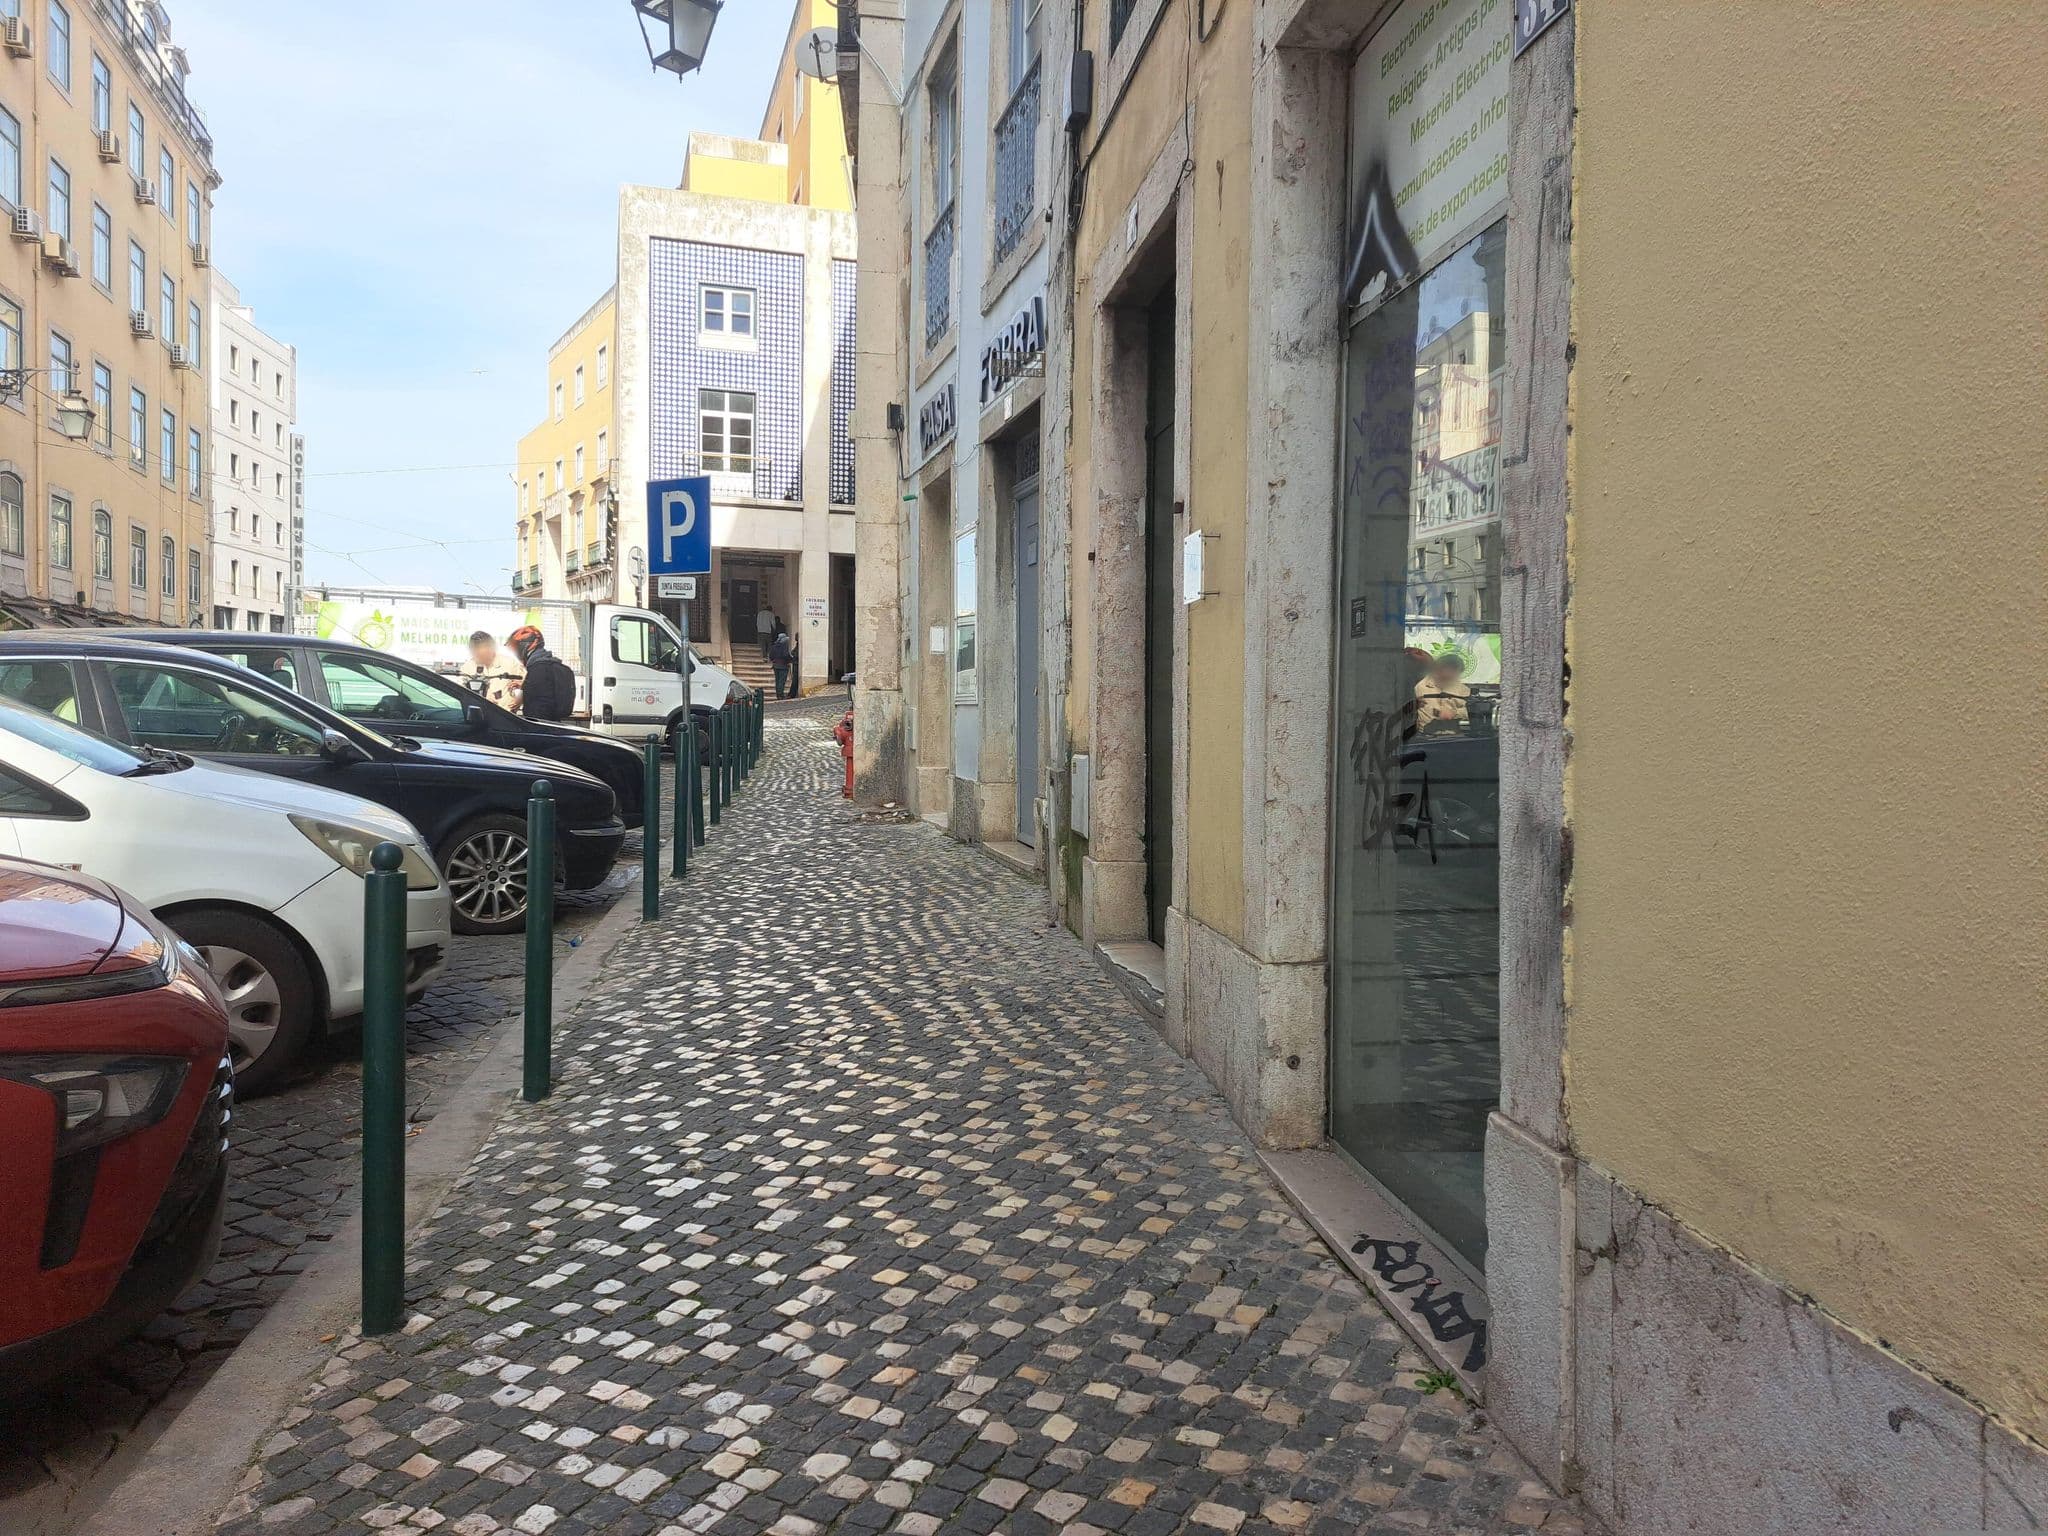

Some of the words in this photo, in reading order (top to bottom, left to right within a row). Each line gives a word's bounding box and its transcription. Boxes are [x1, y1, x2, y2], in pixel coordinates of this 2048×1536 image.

[1387, 63, 1428, 120] Relógios
[1435, 8, 1478, 70] Artigos
[1410, 80, 1454, 146] Material
[1456, 32, 1510, 101] Eléctrico
[1394, 129, 1468, 209] comunicações
[1470, 121, 1478, 142] e
[1426, 208, 1438, 235] de
[1440, 153, 1508, 220] exportação
[921, 384, 956, 450] CASA
[294, 437, 304, 509] HOTEL
[662, 491, 695, 562] P
[400, 617, 430, 628] MAIS
[433, 618, 469, 631] MEIOS
[401, 631, 447, 645] MELHOR
